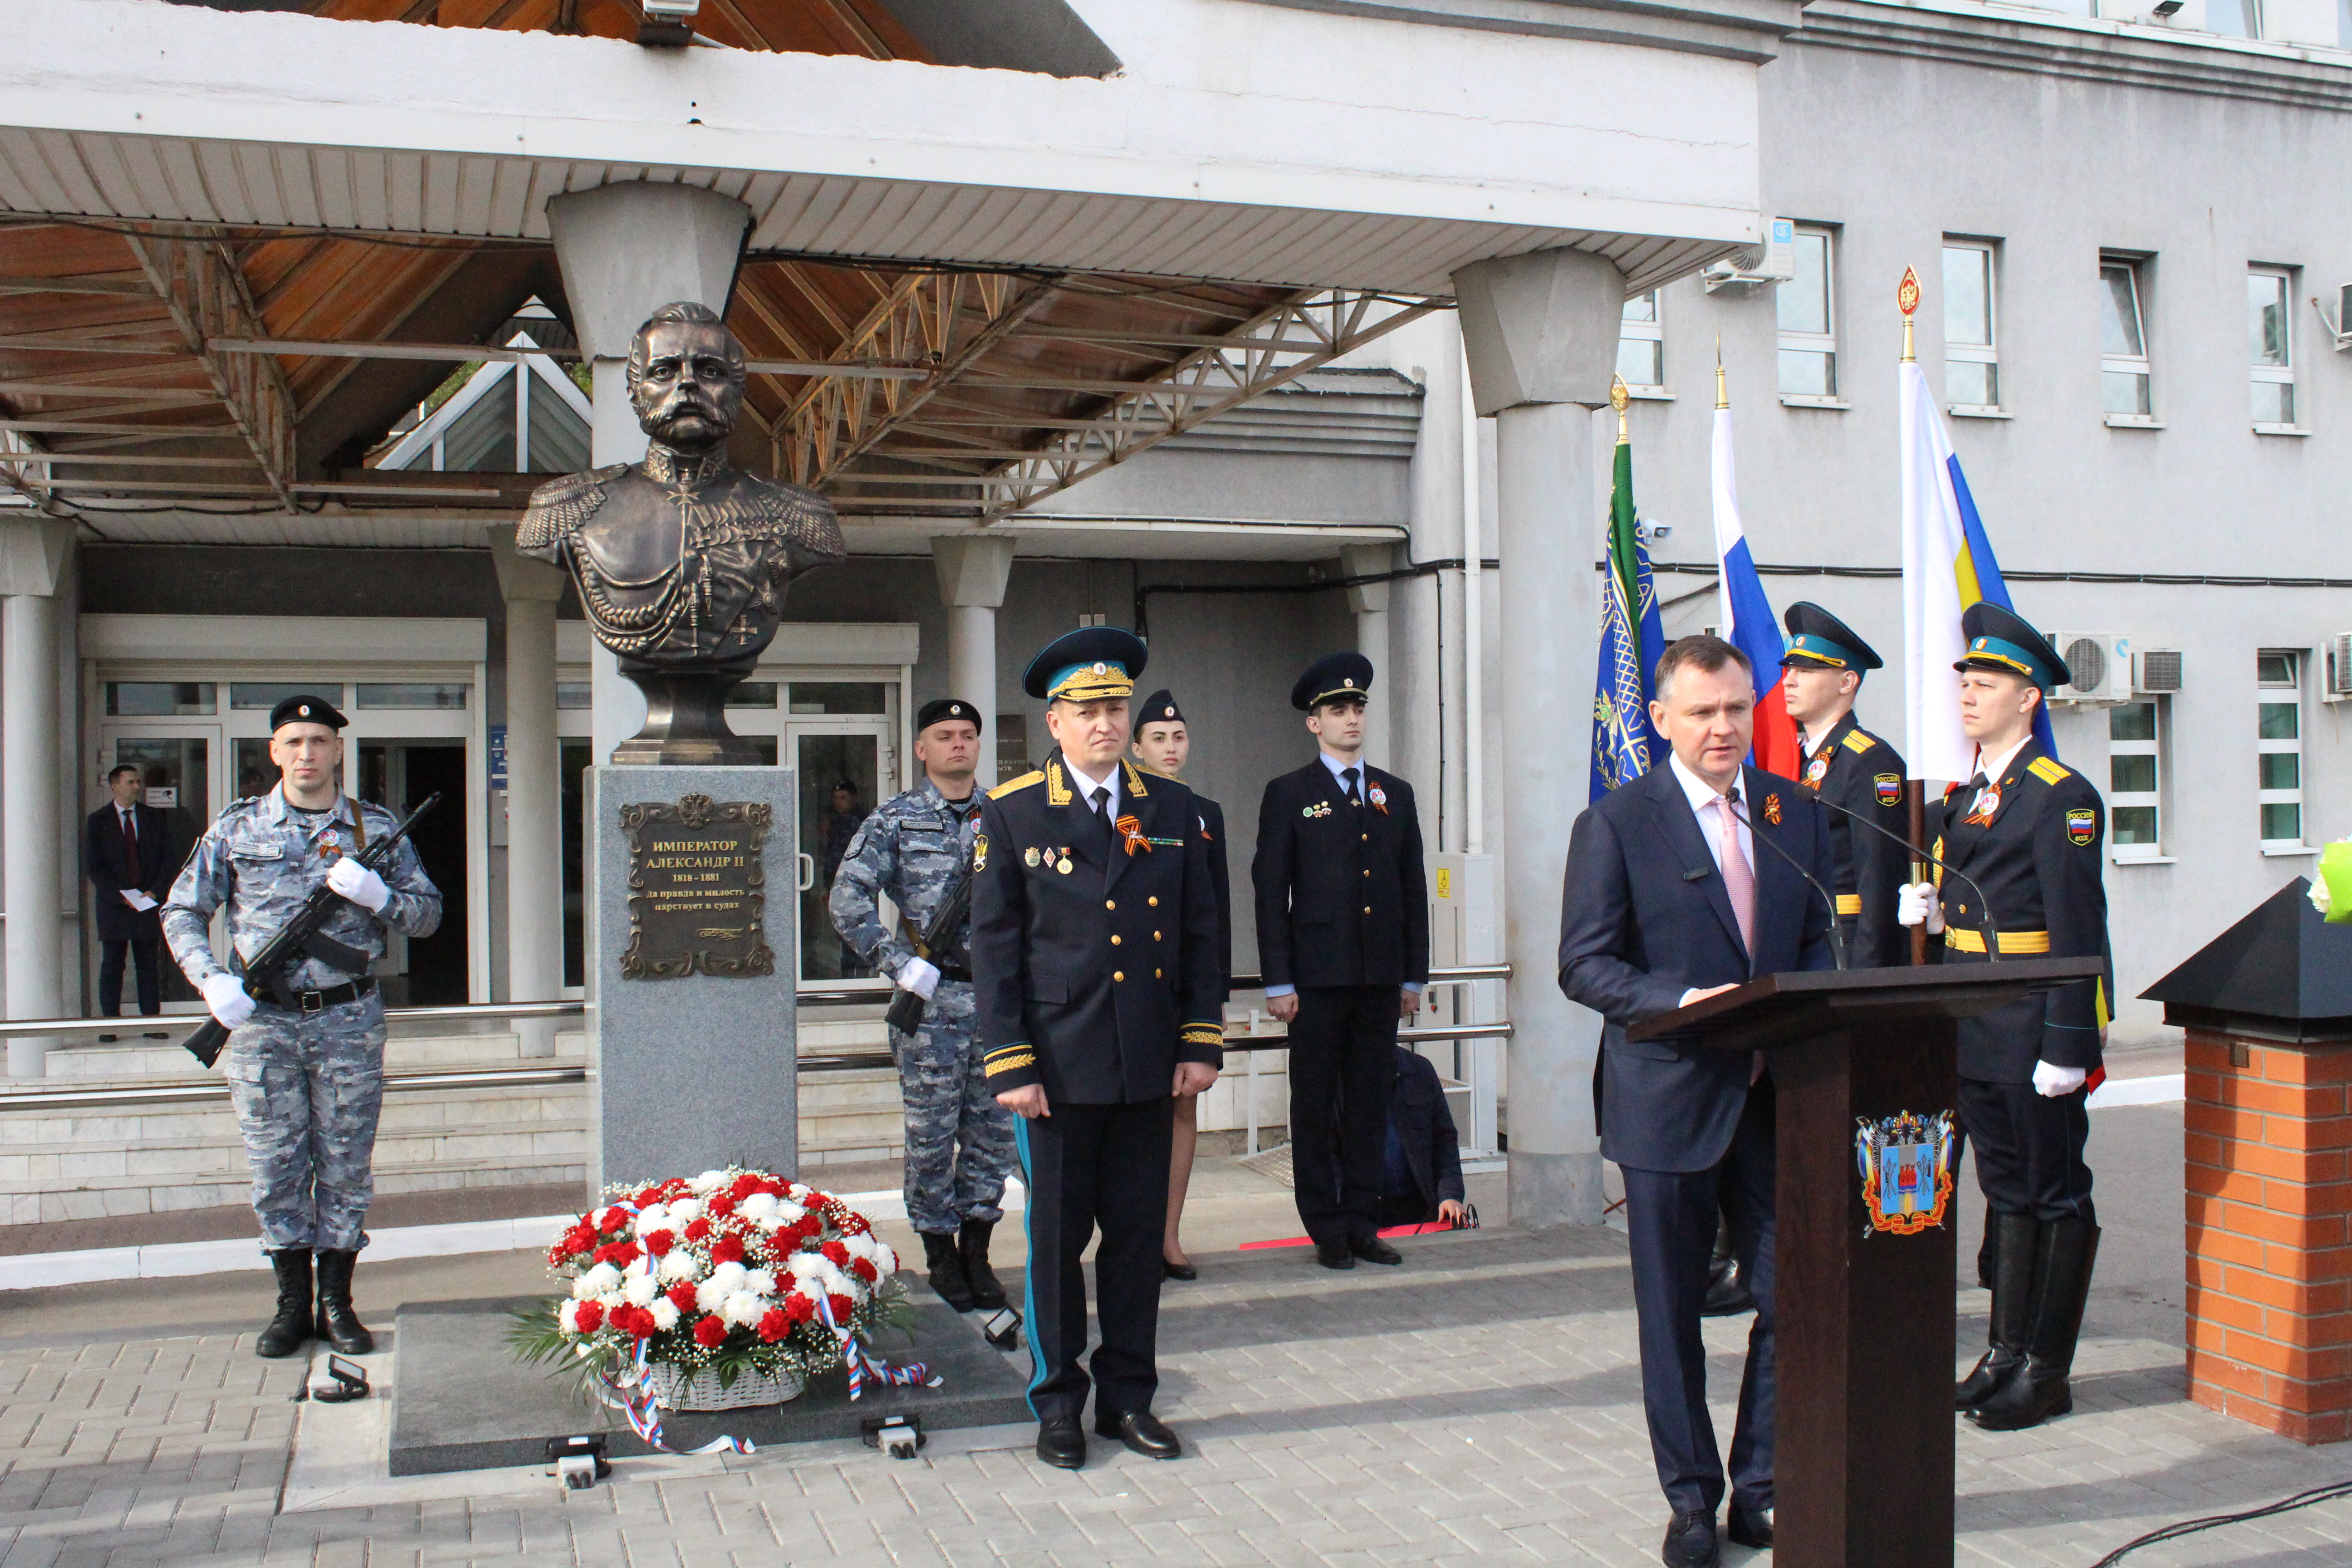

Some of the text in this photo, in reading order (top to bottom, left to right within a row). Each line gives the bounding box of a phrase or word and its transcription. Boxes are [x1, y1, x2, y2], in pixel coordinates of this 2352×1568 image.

[652, 840, 738, 852] ИМПЕРАТОР
[646, 856, 744, 869] АЛЕКСАНДР II
[672, 874, 693, 882] 1818
[700, 873, 720, 882] 1881
[660, 890, 694, 899] правда
[654, 902, 703, 912] царствует
[714, 902, 740, 911] судах
